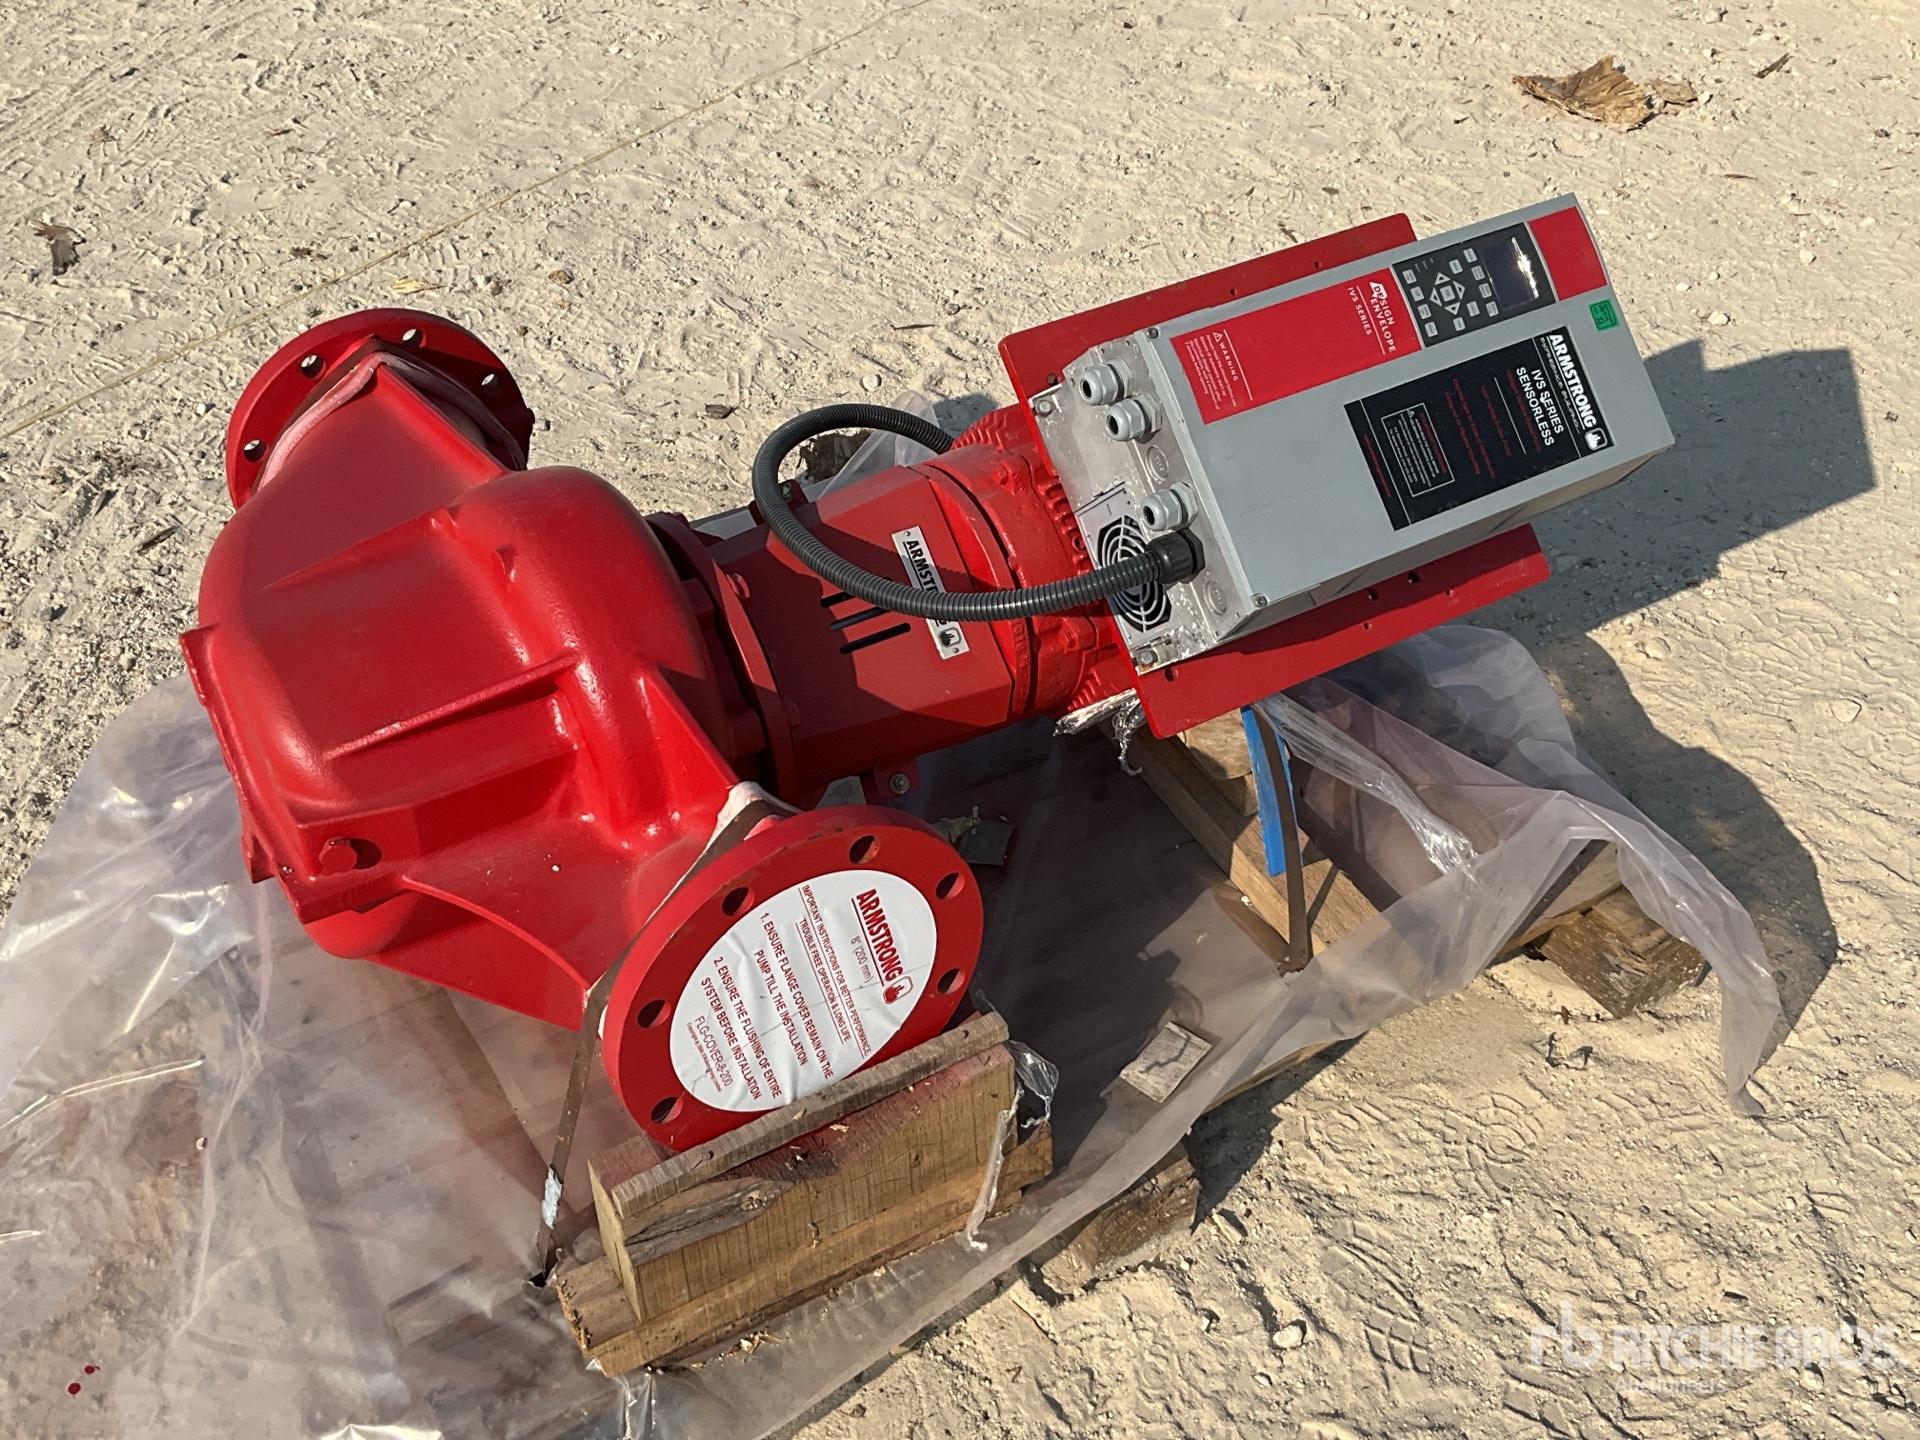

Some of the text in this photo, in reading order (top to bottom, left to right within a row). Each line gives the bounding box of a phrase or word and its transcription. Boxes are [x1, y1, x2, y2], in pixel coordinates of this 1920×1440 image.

[1346, 286, 1372, 335] IVS SERIES
[1369, 297, 1396, 352] ENVELOPE
[1372, 285, 1395, 325] DESIGN
[1218, 341, 1239, 381] WARNING
[1548, 331, 1598, 429] ARMSTRONG
[1514, 366, 1555, 446] SENSORLESS
[1530, 368, 1564, 434] IVS SERIES
[905, 537, 951, 626] ARMST
[801, 883, 822, 925] IMPORTANT
[855, 883, 904, 984] ARMSTRONG
[798, 917, 851, 1042] TROUBLE FREE OPERATION & LONG LIFE
[816, 921, 840, 972] INSTRUCTIONS
[834, 969, 845, 986] FOR
[852, 943, 868, 966] (200
[859, 961, 874, 984] mm)
[713, 954, 781, 1099] 2. ENSURE THE FLUSHING OF ENTIRE
[754, 948, 808, 1066] PUMP TILL THE INSTALLATION
[759, 910, 834, 1079] 1. ENSURE FLANGE COVER REMAIN ON THE
[839, 983, 854, 1011] BETTER
[693, 1014, 733, 1087] FLG-COVER-8-200
[700, 975, 761, 1100] SYSTEM BEFORE INSTALLATION
